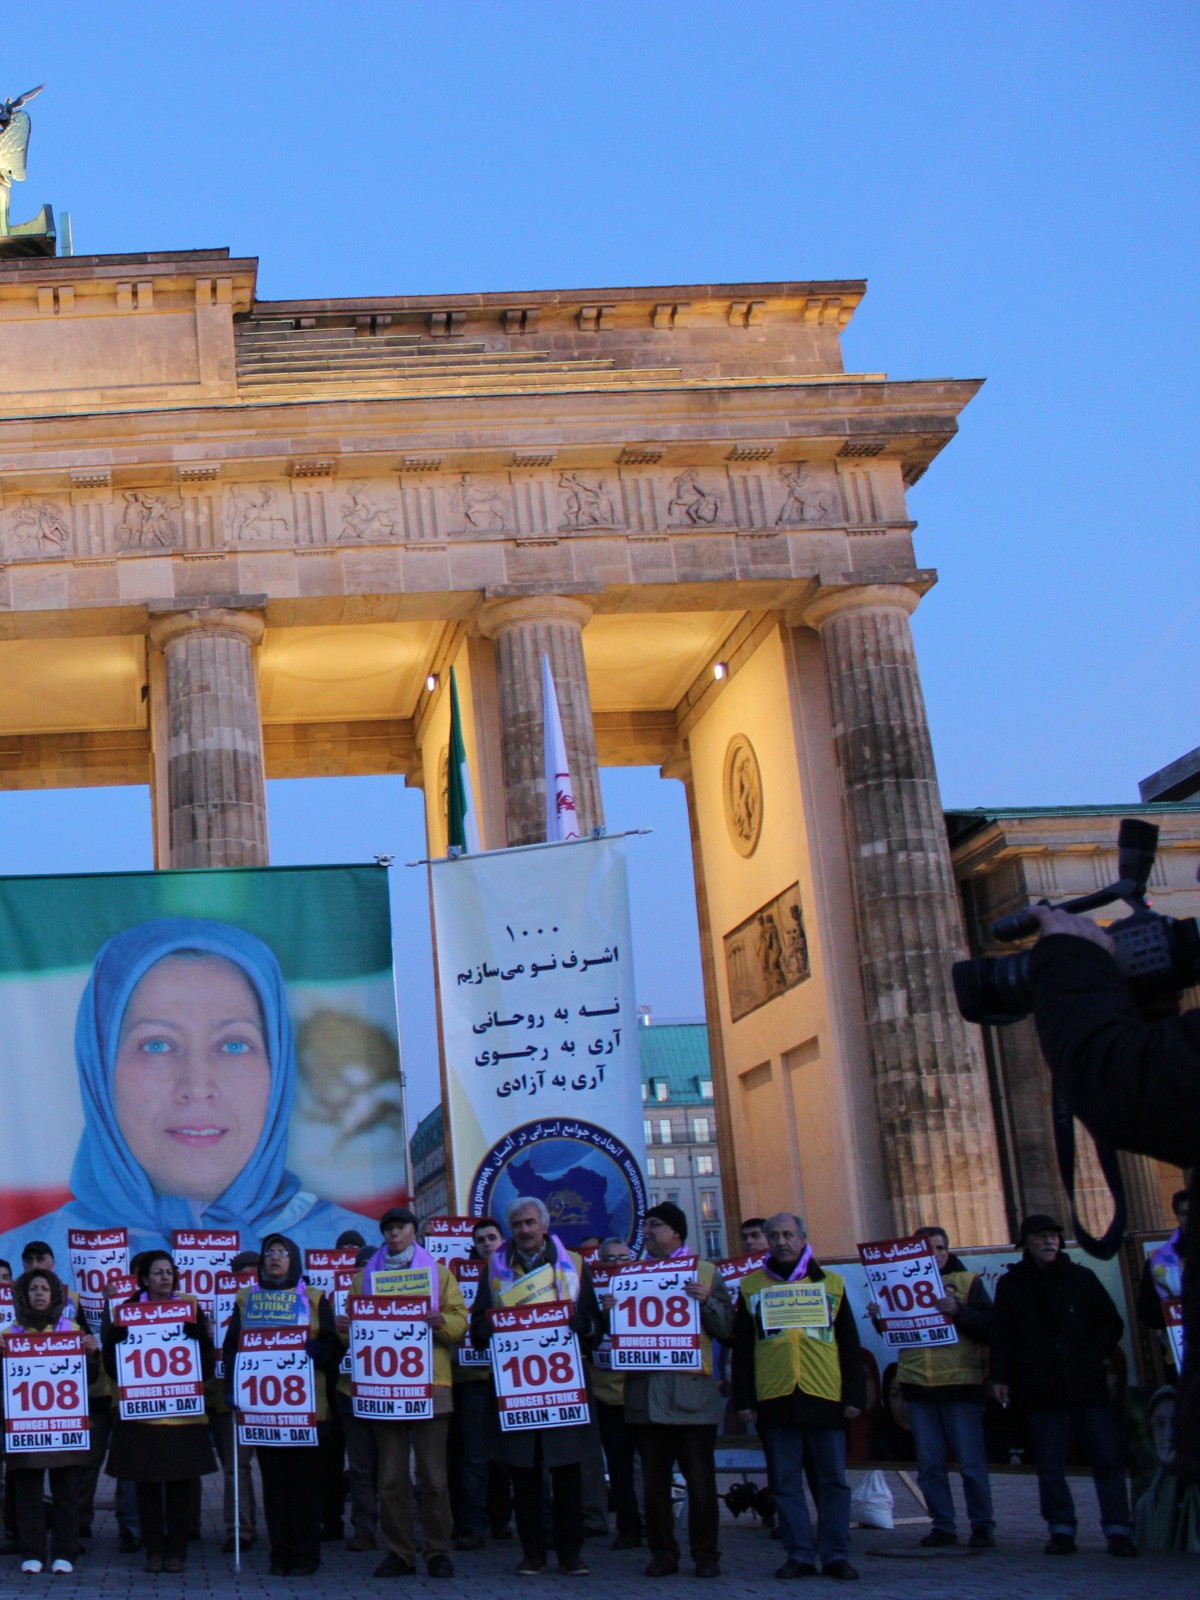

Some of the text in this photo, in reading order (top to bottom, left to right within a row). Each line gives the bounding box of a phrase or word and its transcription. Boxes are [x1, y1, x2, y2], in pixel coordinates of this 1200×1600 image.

[531, 953, 557, 978] نو
[562, 947, 619, 969] اشرف
[554, 1006, 569, 1021] به
[578, 998, 620, 1017] نه
[472, 1010, 544, 1034] روحانی
[475, 1028, 621, 1067] آری به رجوی
[496, 1064, 606, 1098] آری به آزادی
[475, 1167, 494, 1202] Verband
[624, 1160, 645, 1216] Associations
[863, 1239, 927, 1260] اعتصاب غذا
[251, 1292, 296, 1303] HUNGER
[795, 1289, 821, 1297] STRIKE
[878, 1280, 938, 1314] 108
[120, 1308, 140, 1322] غذا
[144, 1305, 191, 1325] اعتصاب
[252, 1302, 292, 1312] STRIKE
[354, 1299, 427, 1316] اعتصاب غذا
[618, 1295, 690, 1328] 108
[492, 1306, 568, 1327] اعتصاب غذا
[914, 1315, 945, 1326] STRIKE
[8, 1336, 81, 1353] اعتصاب غذا
[244, 1330, 307, 1349] اعتصاب غذا
[619, 1336, 693, 1347] HUNGER STRIKE
[889, 1328, 950, 1344] BERLIN DAY
[124, 1346, 192, 1379] 108
[356, 1346, 424, 1378] 108
[618, 1350, 694, 1364] BERLIN DAY
[502, 1352, 574, 1388] 108
[12, 1380, 80, 1412] 108
[126, 1383, 196, 1398] HUNGER STRIKE
[241, 1375, 306, 1407] 108
[357, 1386, 426, 1397] HUNGER STRIKE
[127, 1397, 197, 1414] BERLIN DAY
[357, 1400, 427, 1413] BERLIN DAY
[506, 1392, 579, 1409] HUNGER STRIKE
[12, 1418, 82, 1431] HUNGER STRIKE
[244, 1414, 308, 1425] HUNGER STRIKE
[507, 1406, 581, 1425] BERLIN DAY
[12, 1432, 83, 1447] BERLIN DAY
[245, 1428, 311, 1441] BERLIN DAY
